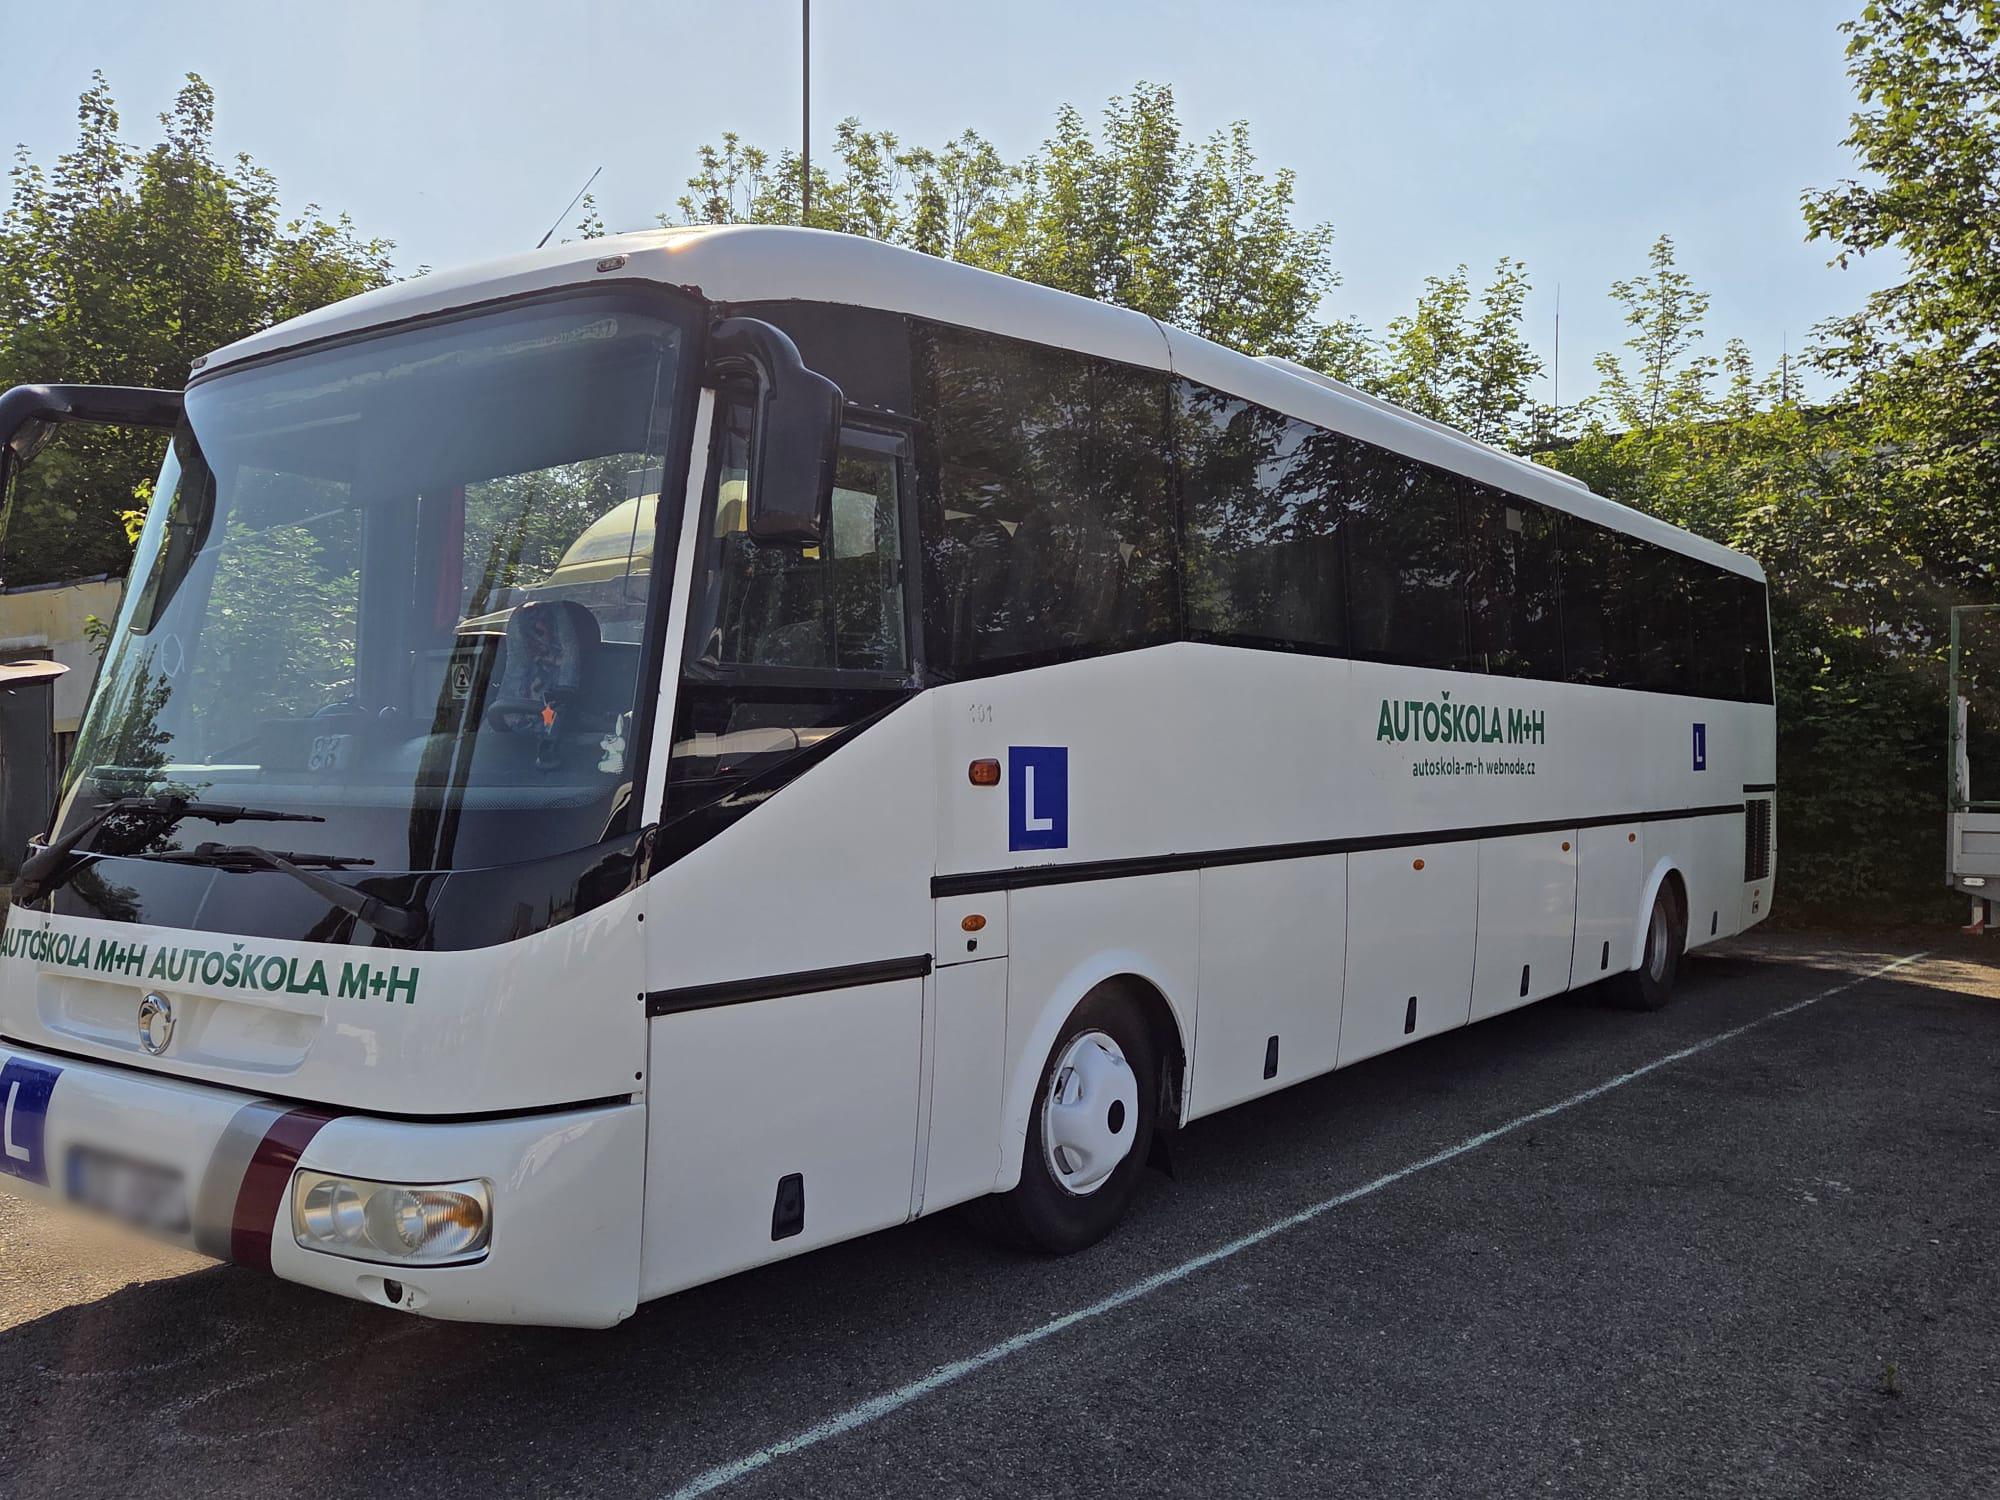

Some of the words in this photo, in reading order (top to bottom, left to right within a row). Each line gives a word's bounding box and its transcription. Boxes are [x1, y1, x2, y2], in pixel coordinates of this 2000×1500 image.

[1377, 691, 1503, 743] AUTOŠKOLA
[1507, 708, 1545, 744] M+H
[1695, 731, 1703, 763] L
[1412, 756, 1484, 777] autoskola-m-h
[1486, 757, 1536, 775] webnode.cz
[1025, 765, 1053, 831] L
[0, 922, 91, 969] AUTOŠKOLA
[93, 939, 148, 977] M+H
[148, 942, 329, 997] AUTOŠKOLA
[337, 962, 420, 1005] M+H
[4, 1081, 30, 1162] L
